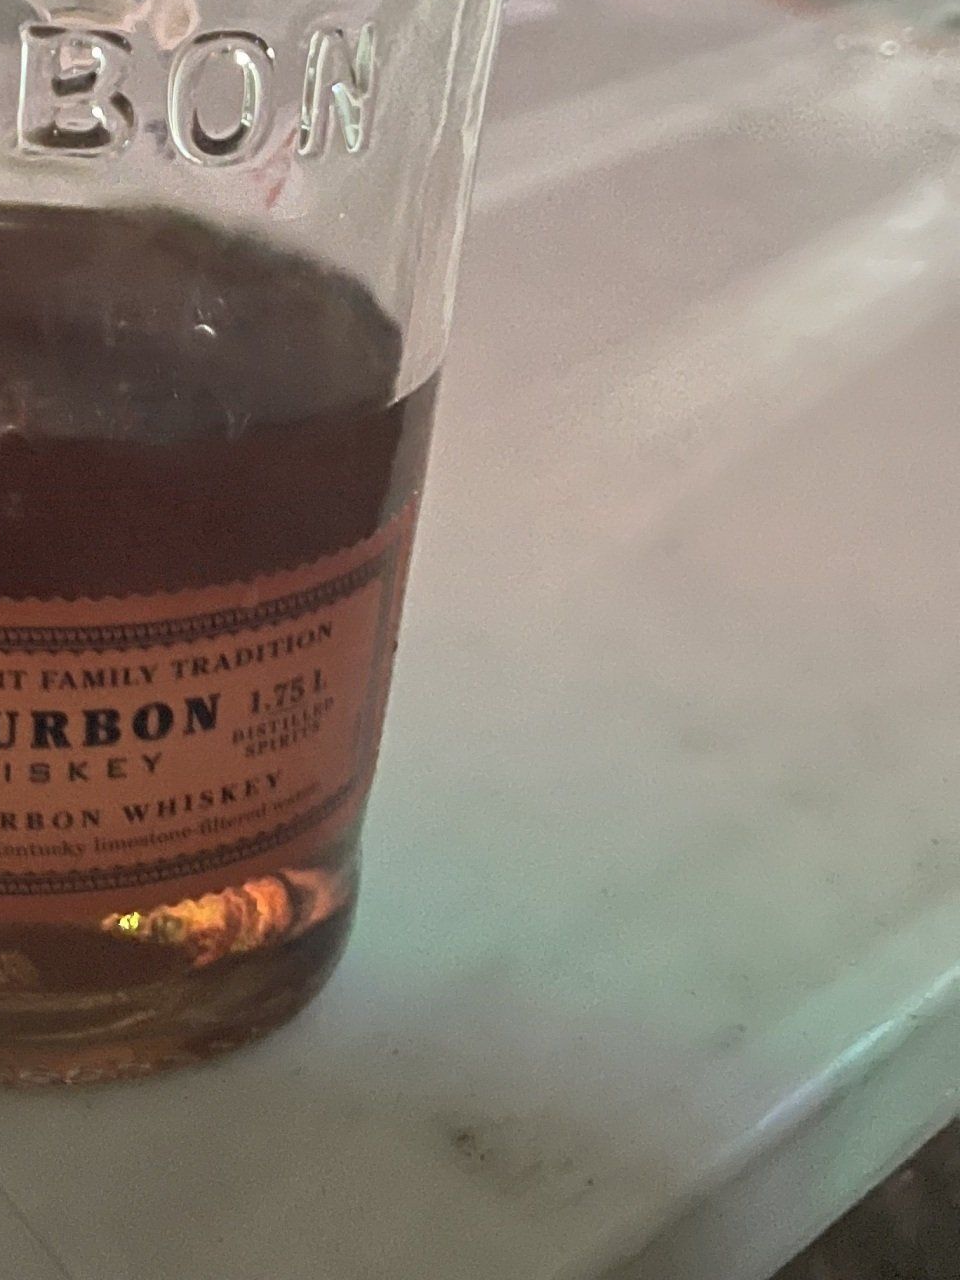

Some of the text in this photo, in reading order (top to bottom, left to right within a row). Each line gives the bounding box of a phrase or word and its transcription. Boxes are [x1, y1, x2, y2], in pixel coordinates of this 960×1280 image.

[41, 664, 159, 693] FAMILY
[172, 621, 333, 681] TRADITION
[250, 676, 306, 715] 1.75
[123, 770, 281, 822] WHISKEY
